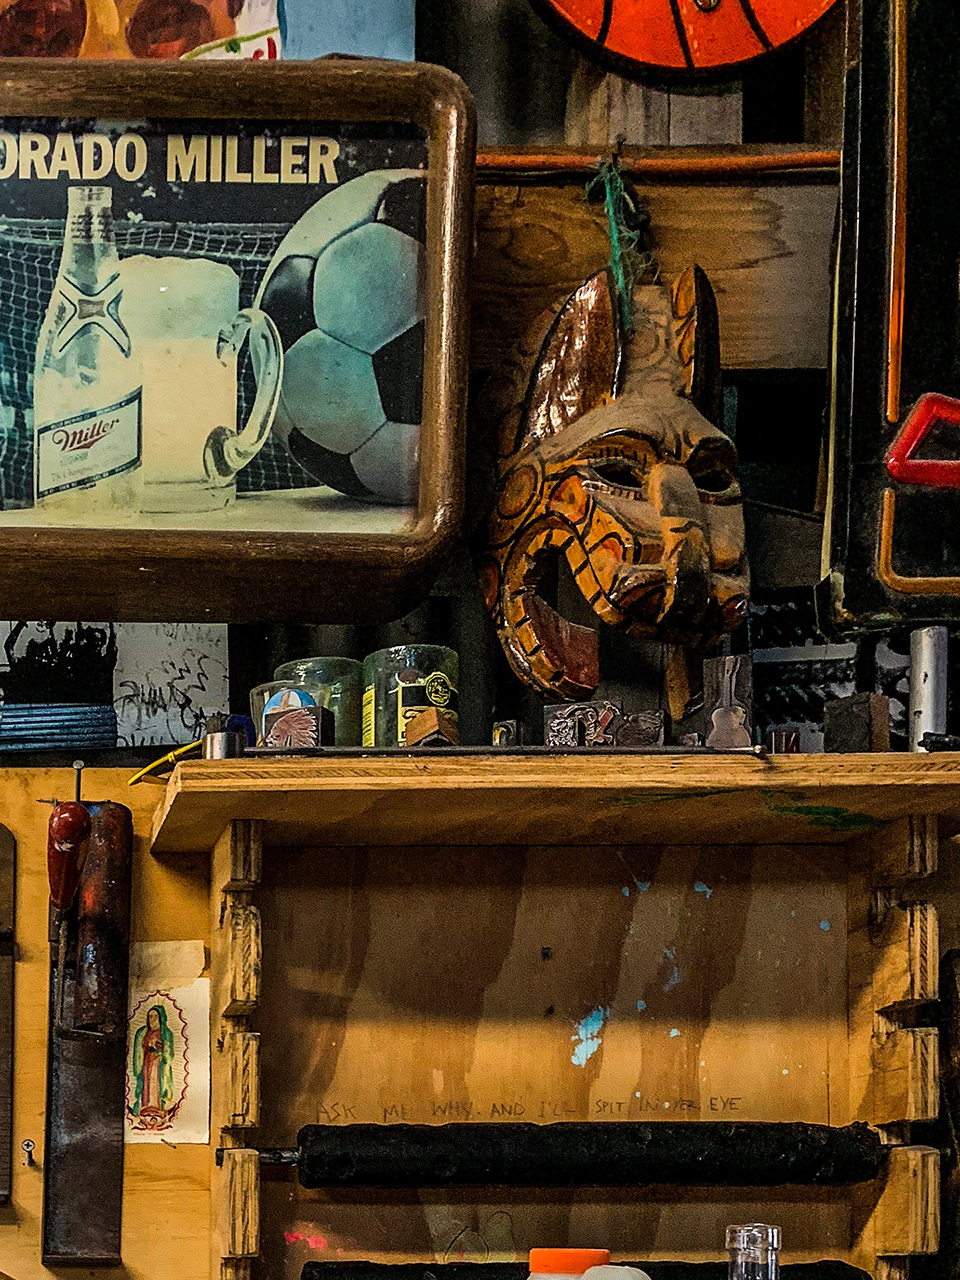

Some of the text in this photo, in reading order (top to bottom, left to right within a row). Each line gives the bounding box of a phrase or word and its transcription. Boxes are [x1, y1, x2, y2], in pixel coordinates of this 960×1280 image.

[166, 134, 340, 184] MILLER
[51, 418, 120, 452] Miller
[316, 1102, 357, 1124] ASK
[383, 1103, 410, 1122] ME
[490, 1102, 526, 1119] AND
[595, 1099, 626, 1114] SPIT
[710, 1097, 743, 1112] EYE
